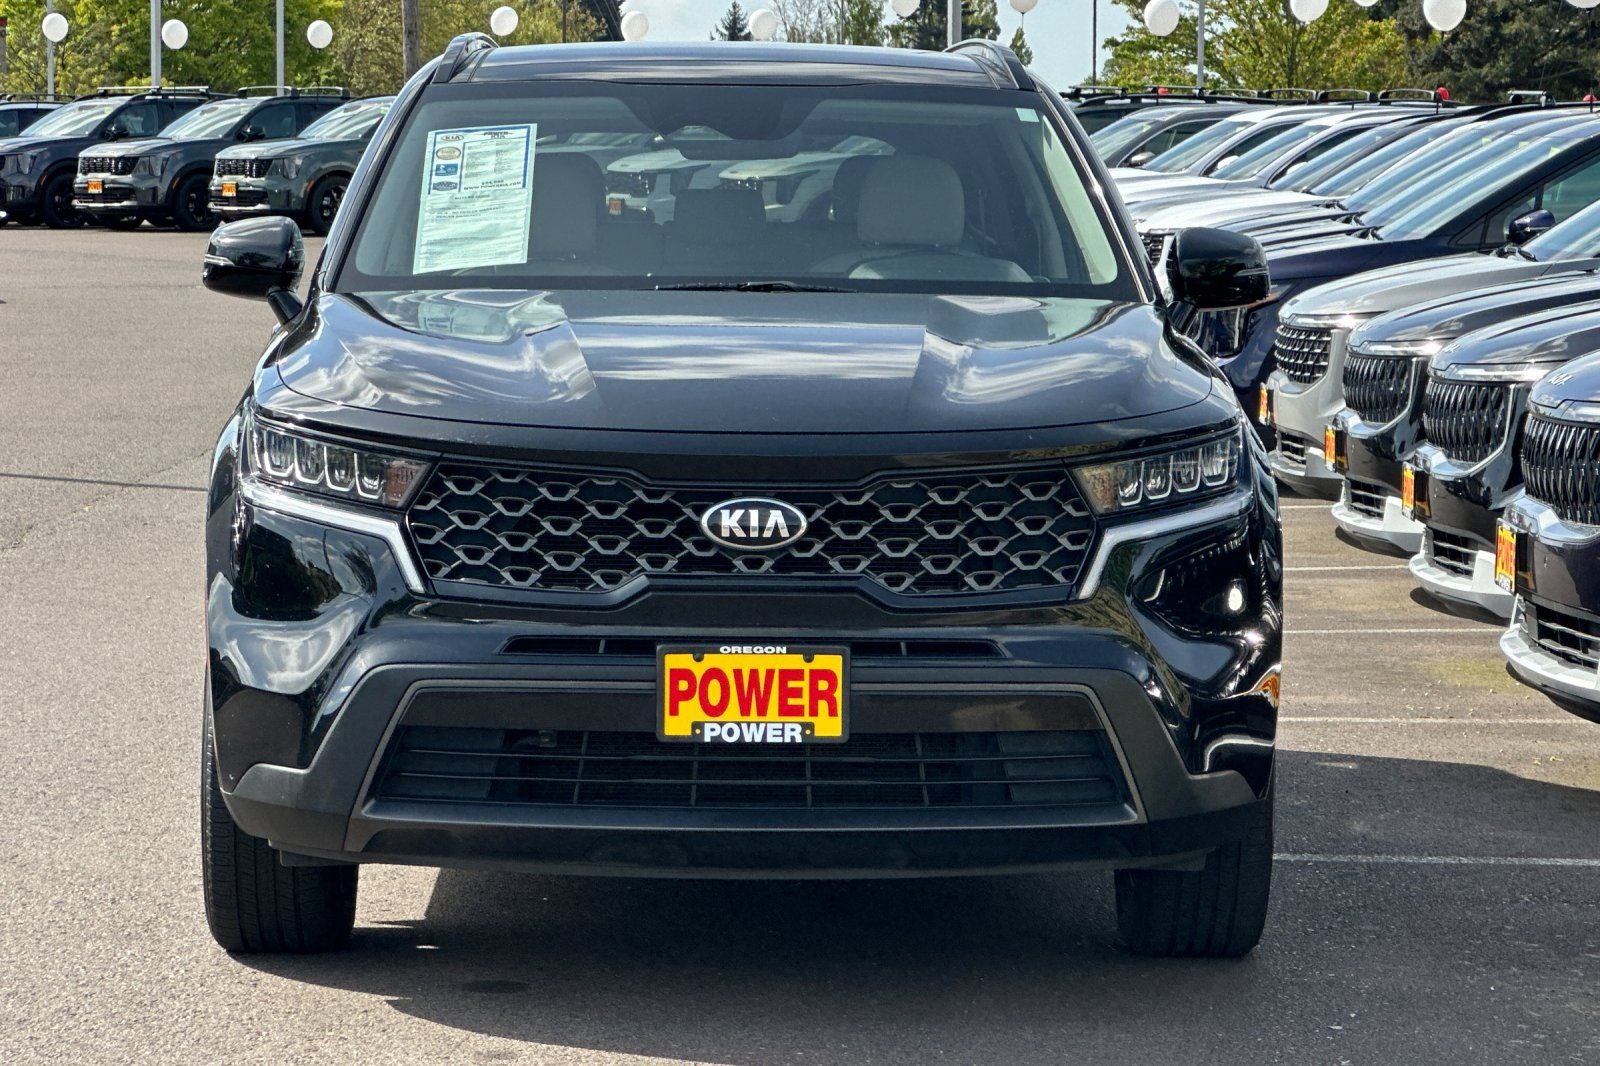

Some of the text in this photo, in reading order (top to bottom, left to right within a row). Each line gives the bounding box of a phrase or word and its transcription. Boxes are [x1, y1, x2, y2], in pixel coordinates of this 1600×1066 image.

[720, 509, 790, 538] KIA
[719, 645, 787, 654] OREGON
[668, 667, 839, 718] POWER
[703, 722, 803, 743] POWER
